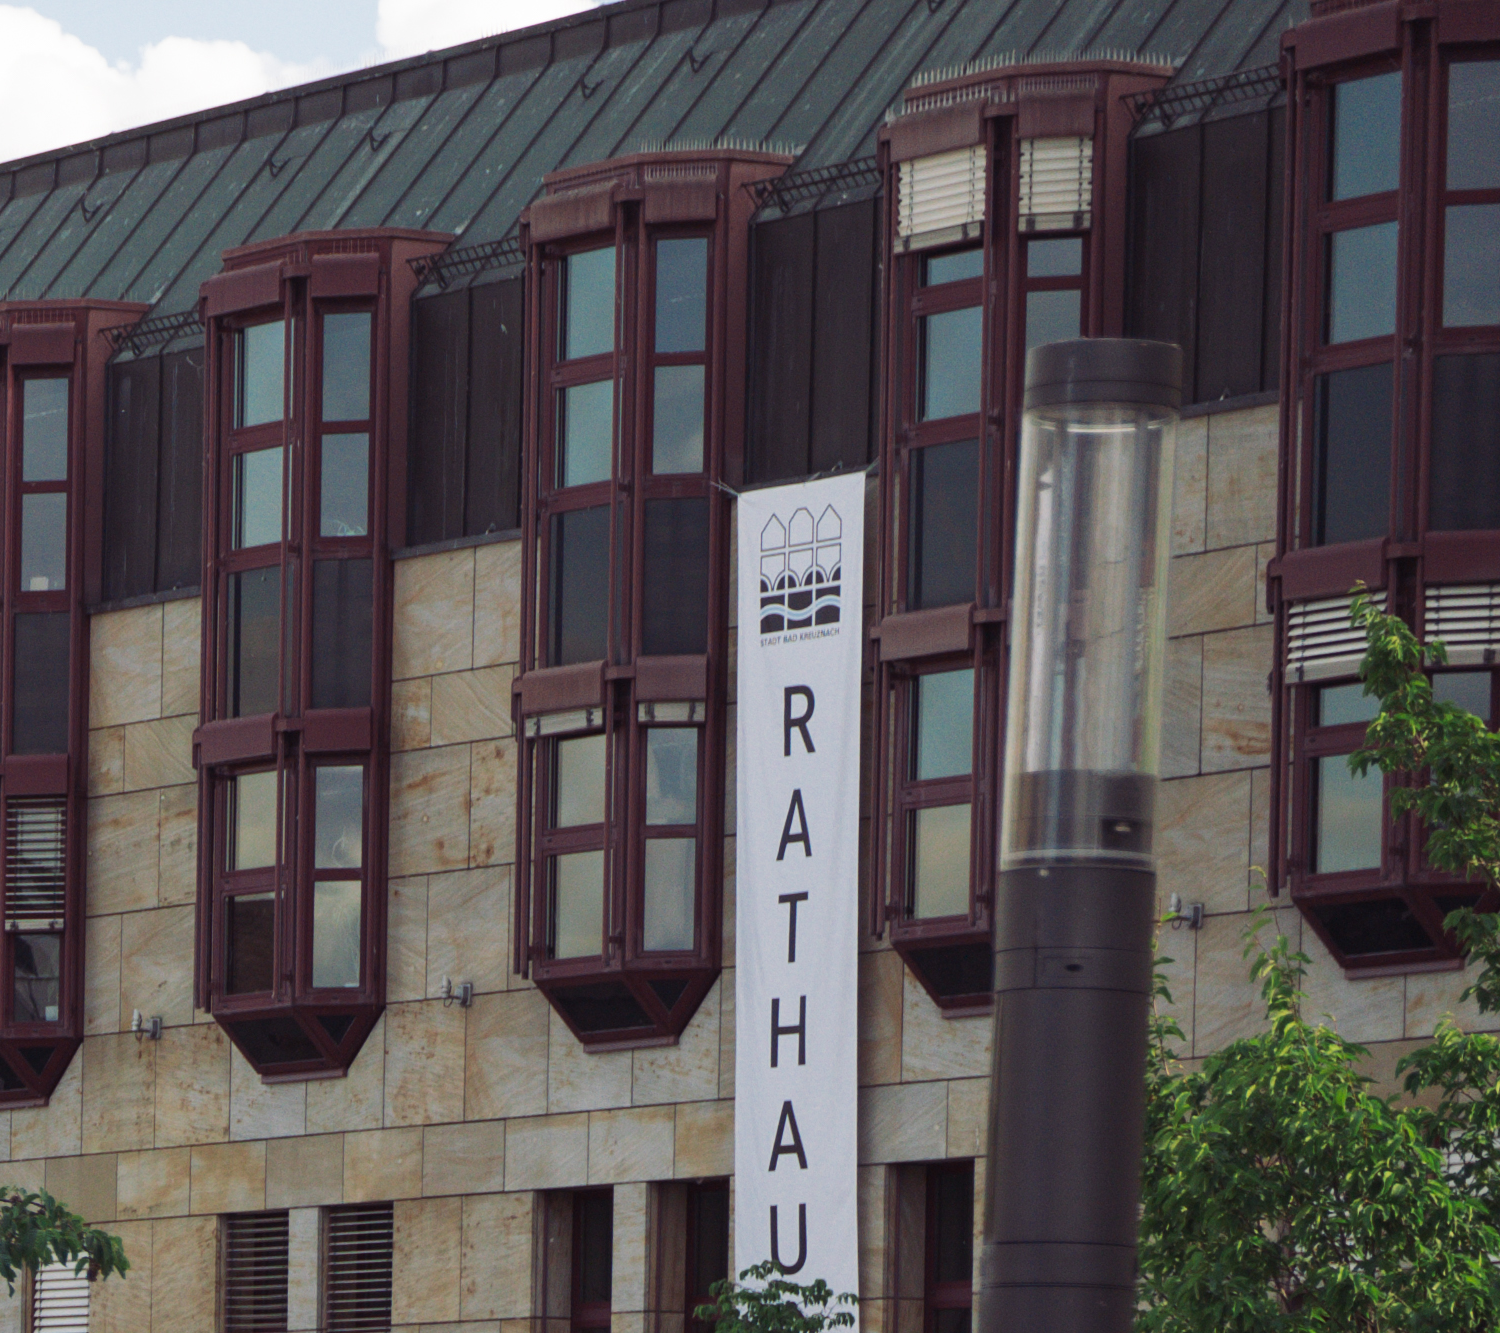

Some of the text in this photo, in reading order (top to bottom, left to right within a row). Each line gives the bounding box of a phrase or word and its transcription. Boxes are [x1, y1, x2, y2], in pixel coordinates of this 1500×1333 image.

[760, 627, 840, 647] STADT BAD KREUZNACH
